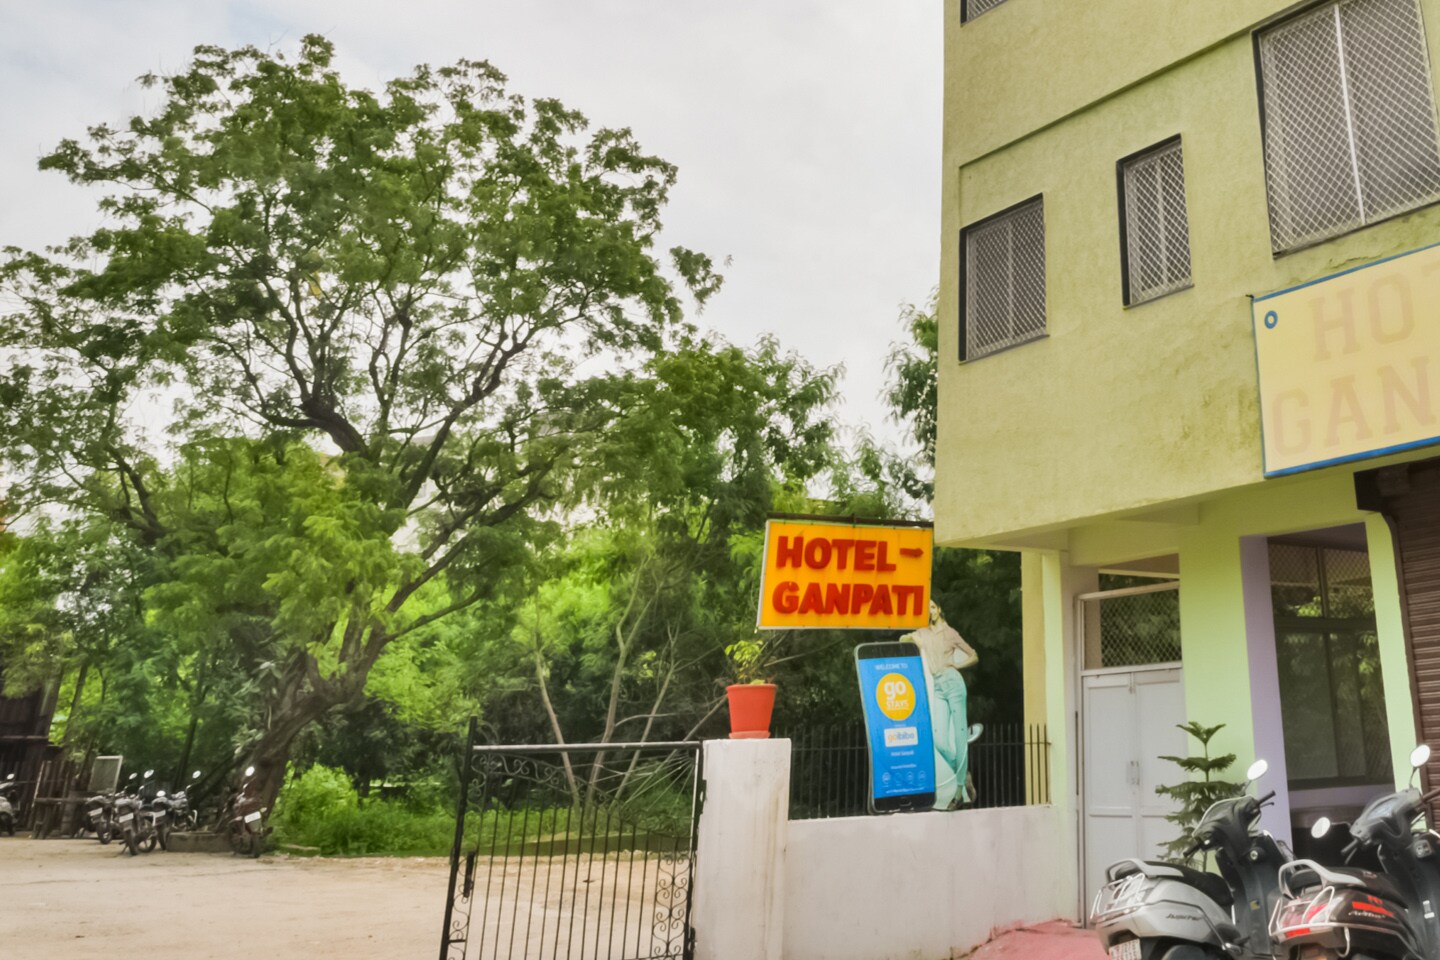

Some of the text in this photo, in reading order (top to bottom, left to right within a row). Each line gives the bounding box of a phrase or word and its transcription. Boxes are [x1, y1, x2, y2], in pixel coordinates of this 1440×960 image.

[776, 535, 896, 572] HOTEL
[772, 581, 924, 616] GANPATI
[884, 680, 907, 701] go
